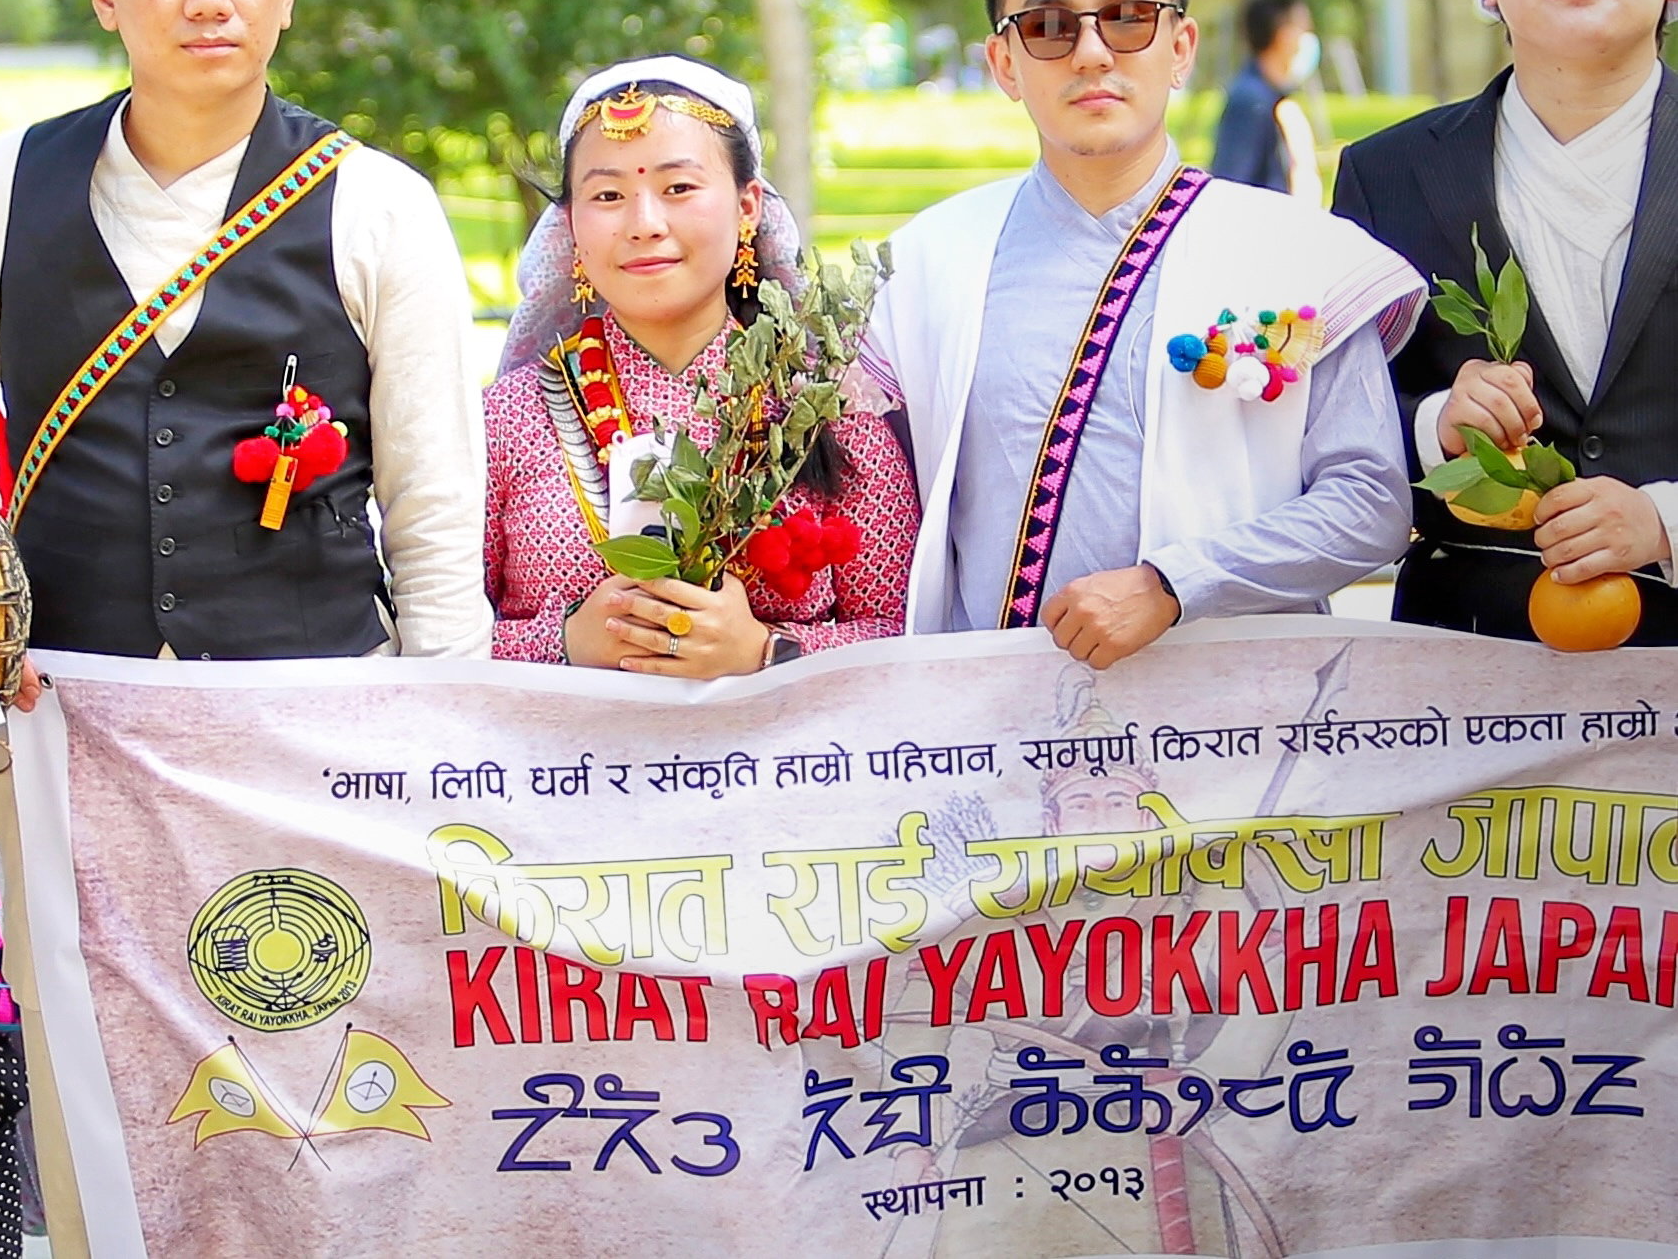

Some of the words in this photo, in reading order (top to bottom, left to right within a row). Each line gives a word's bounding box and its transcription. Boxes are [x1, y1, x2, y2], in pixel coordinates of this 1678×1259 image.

[529, 753, 593, 798] धर्म
[605, 763, 631, 795] र
[645, 751, 760, 799] संकृति
[773, 742, 853, 789] हाम्रो
[867, 741, 1003, 782] पहिचान,
[1020, 722, 1139, 777] सम्पूर्ण
[1150, 725, 1263, 764] किरात
[1463, 712, 1567, 745] एकता
[1579, 699, 1661, 743] हाम्रो
[427, 823, 733, 966] किरात
[763, 811, 935, 957] राई
[214, 993, 242, 1015] KIRAT
[240, 1009, 257, 1024] RAI
[446, 946, 713, 1048] KIRAT
[743, 956, 889, 1051] RAI
[918, 900, 1401, 1027] YAYOKKHA
[861, 1176, 986, 1221] स्थापना
[1049, 1166, 1145, 1201] २०१३
